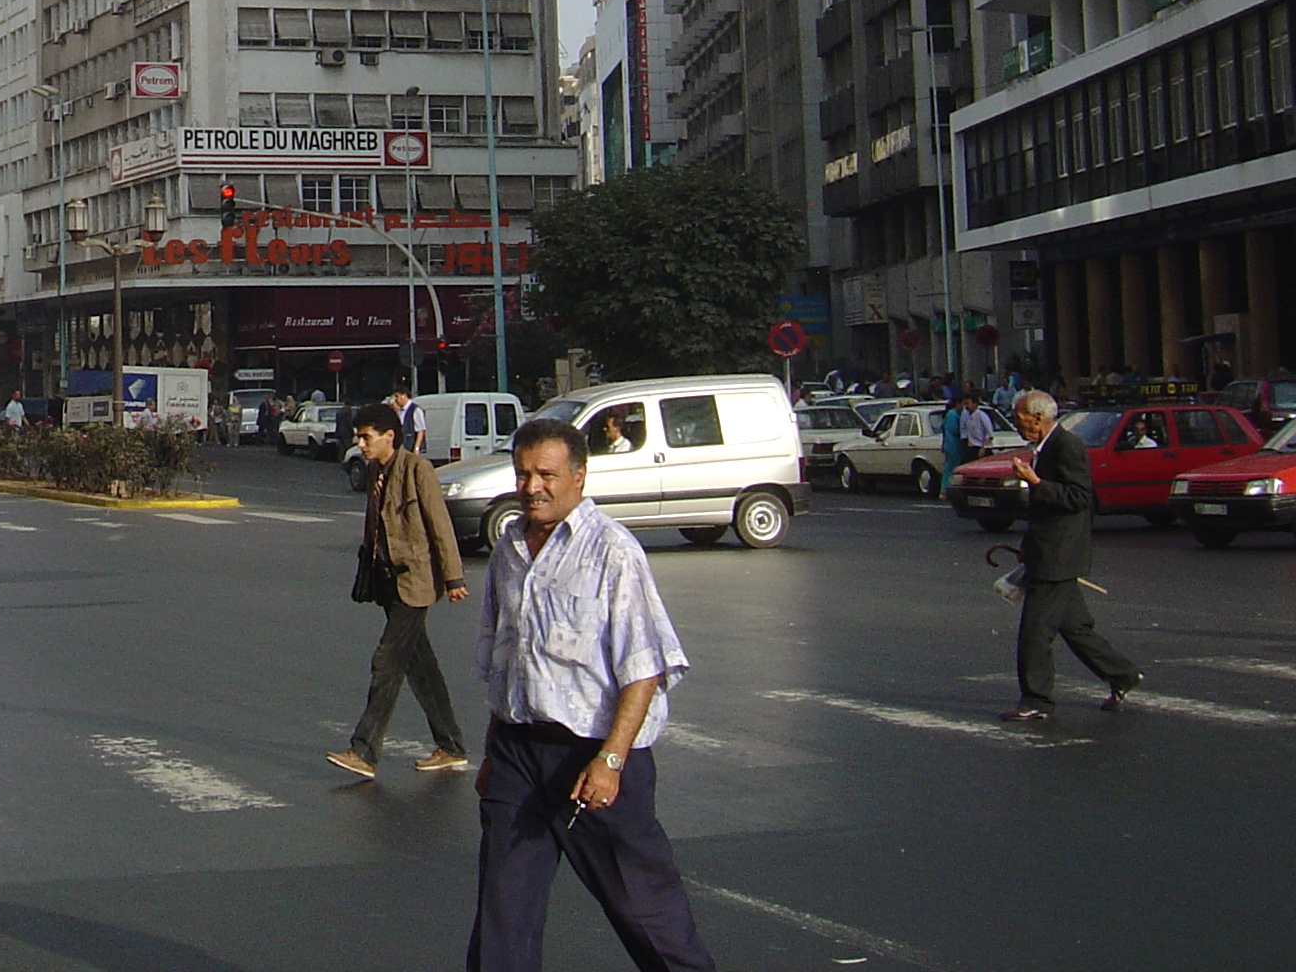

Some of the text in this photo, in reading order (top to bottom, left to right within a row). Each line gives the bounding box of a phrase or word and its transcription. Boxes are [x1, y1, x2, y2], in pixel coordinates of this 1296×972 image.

[140, 74, 173, 87] Petrom
[183, 129, 259, 151] PETROLE
[263, 130, 288, 151] DU
[292, 130, 378, 151] MAGHREB
[242, 205, 376, 233] restaurant
[141, 230, 208, 266] Les
[284, 315, 335, 327] Restaurant
